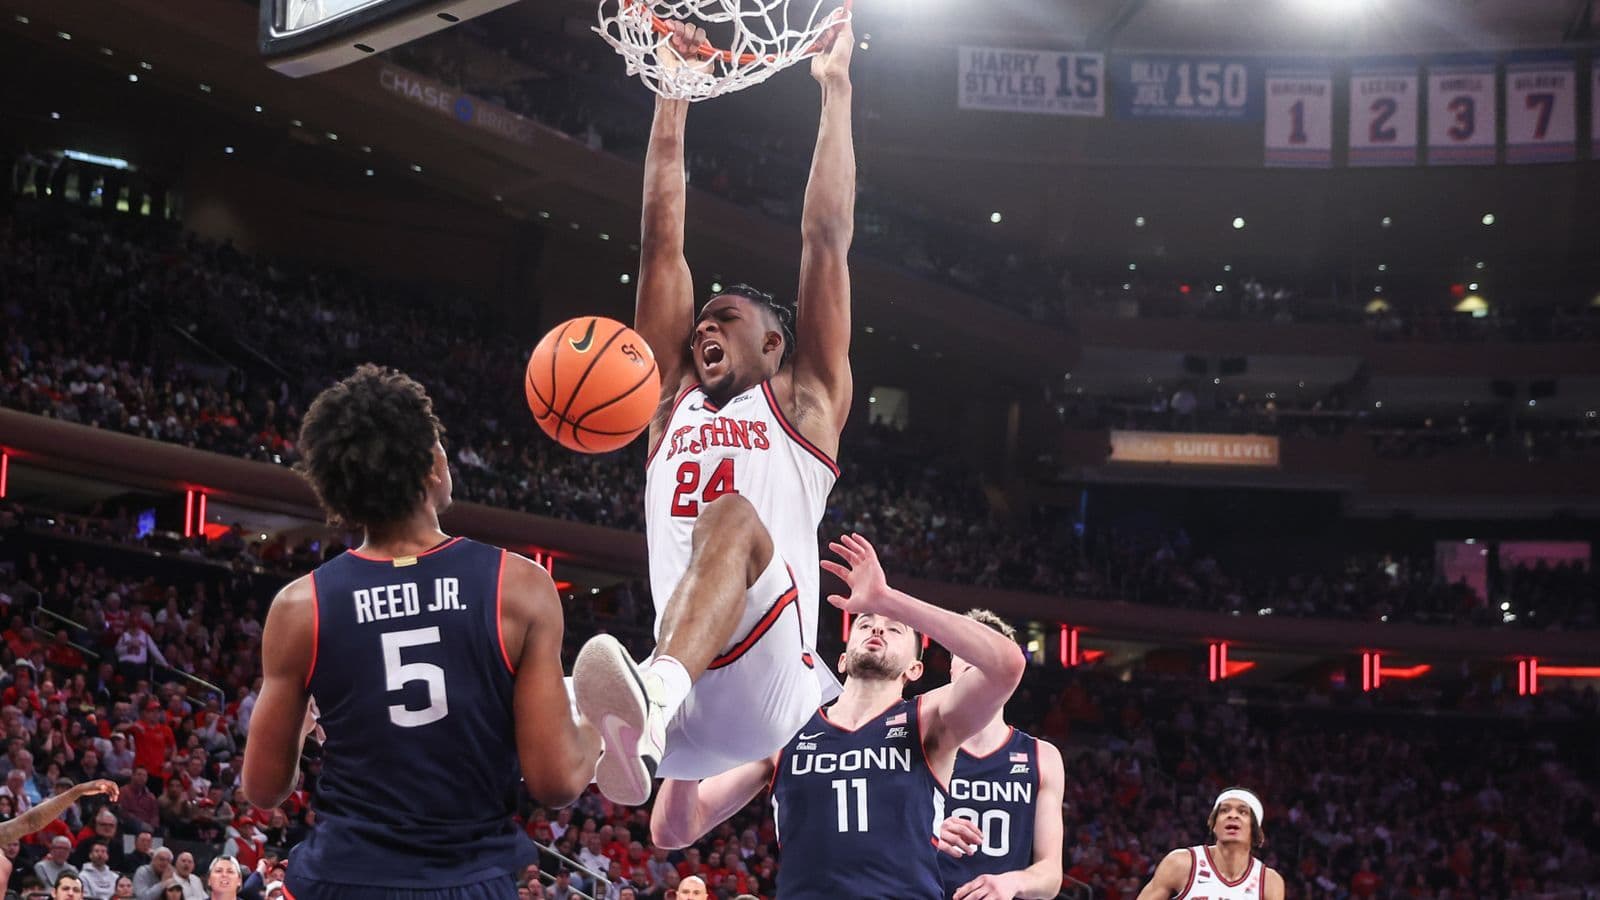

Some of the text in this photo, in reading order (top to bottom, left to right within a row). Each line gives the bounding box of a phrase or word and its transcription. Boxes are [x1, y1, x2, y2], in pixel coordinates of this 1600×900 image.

[965, 73, 1046, 97] STYLES
[971, 52, 1040, 74] HARRY
[1055, 55, 1099, 99] 15
[1175, 62, 1249, 107] 150
[379, 68, 451, 112] CHASE
[1288, 99, 1307, 144] 1
[1369, 97, 1397, 143] 2
[1447, 95, 1475, 141] 3
[1525, 93, 1555, 139] 7
[1174, 440, 1218, 458] SUITE
[1224, 442, 1273, 459] LEVEL
[671, 458, 739, 518] 24
[353, 577, 467, 624] REED JR.
[380, 626, 449, 728] 5
[791, 747, 911, 775] UCONN
[831, 778, 869, 833] 11
[951, 778, 1032, 804] CONN
